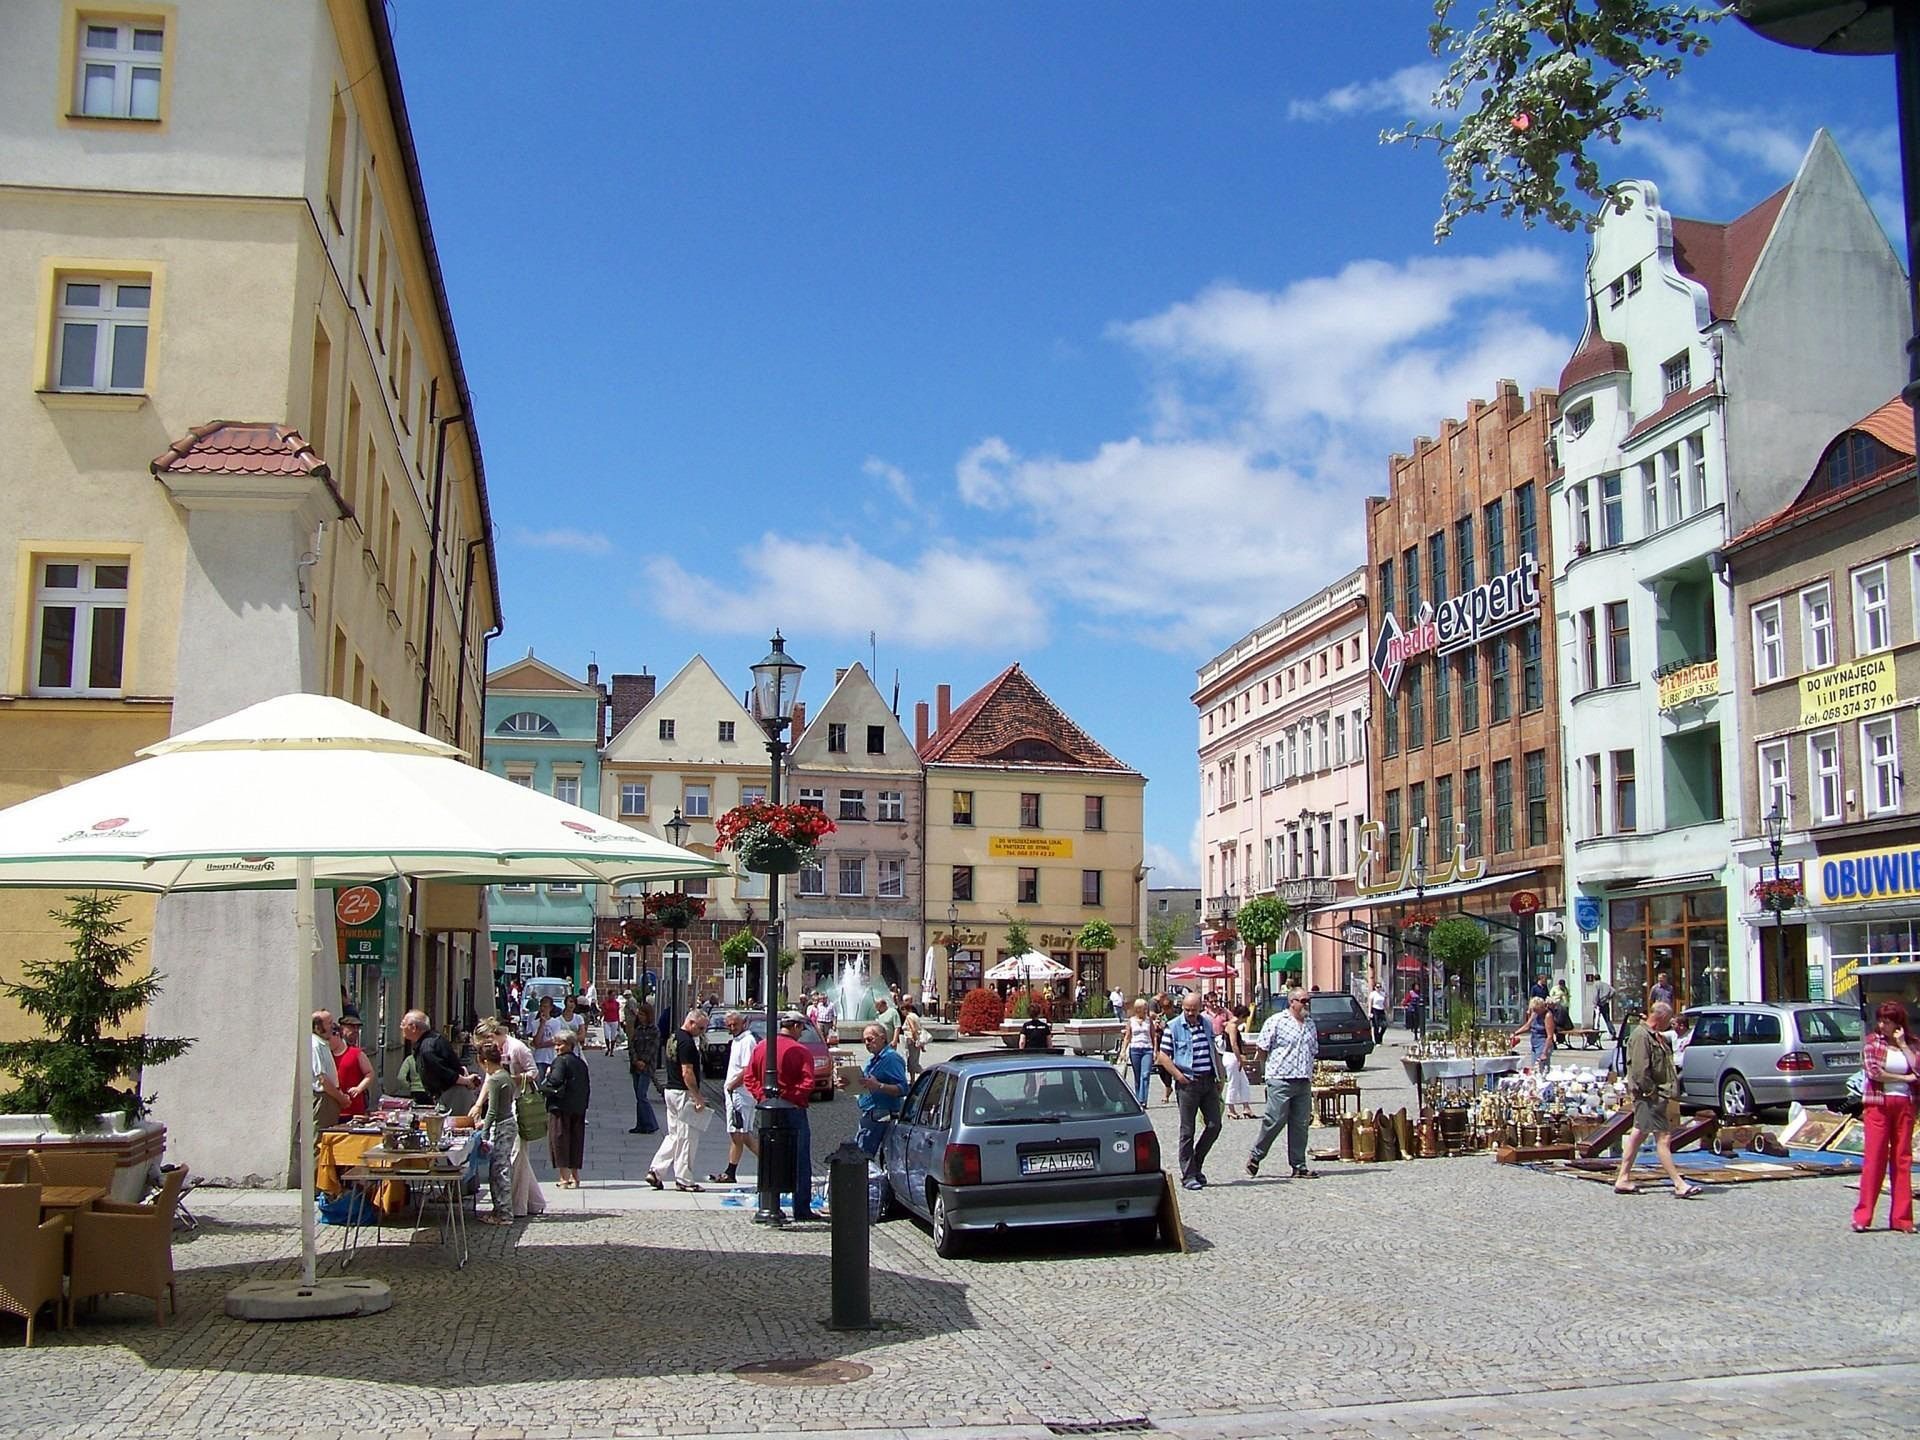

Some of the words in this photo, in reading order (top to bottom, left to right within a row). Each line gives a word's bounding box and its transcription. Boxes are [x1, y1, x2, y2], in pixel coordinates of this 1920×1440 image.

[1388, 621, 1436, 666] media
[1437, 555, 1534, 641] expert
[1807, 678, 1820, 692] DO
[1823, 660, 1886, 687] WYNAJĘCIA
[1816, 694, 1821, 706] I
[1829, 690, 1836, 703] II
[1842, 701, 1861, 716] 374
[1863, 697, 1877, 711] 37
[1880, 694, 1894, 707] 10
[343, 894, 370, 915] 24
[337, 929, 382, 938] ANKOMAT
[931, 929, 988, 946] Zjazd
[1040, 934, 1075, 951] Stary
[1116, 1143, 1127, 1151] PL
[1029, 1155, 1057, 1171] FZA
[1060, 1152, 1092, 1168] H706
